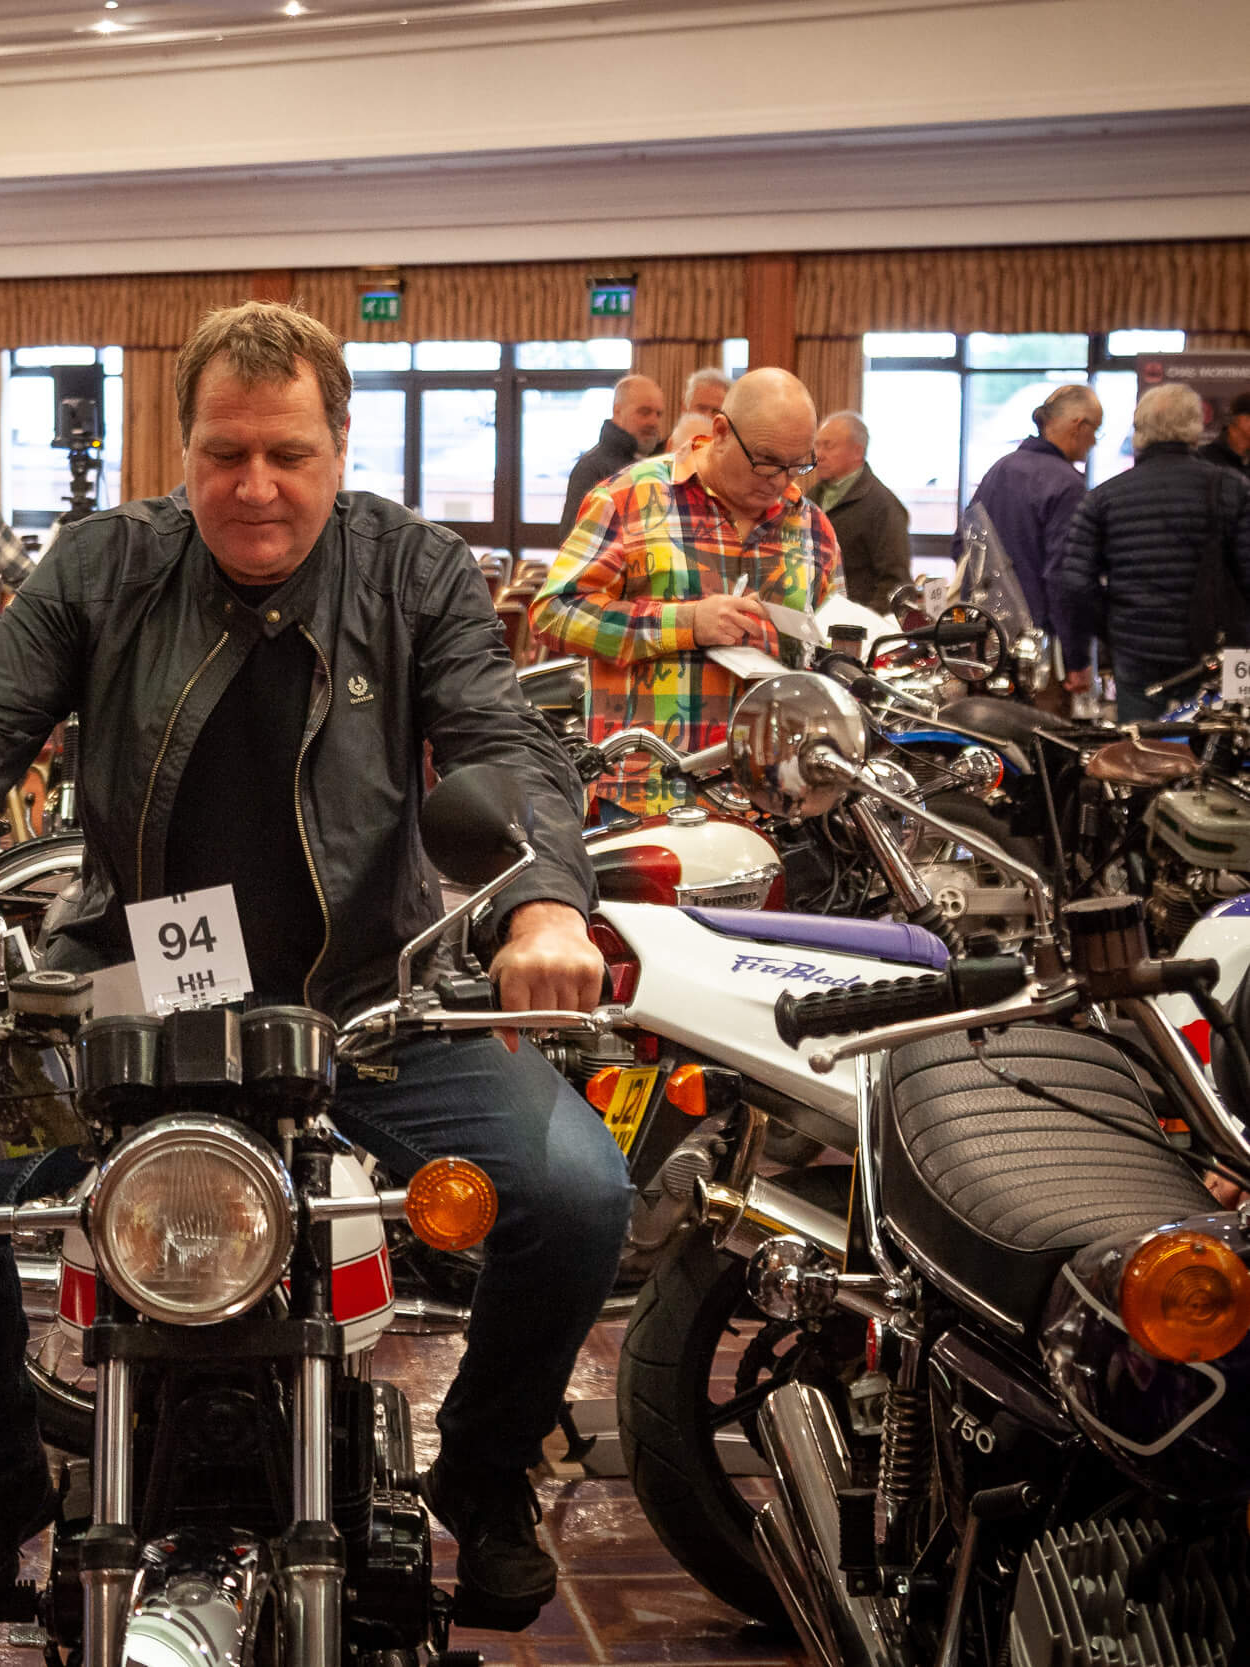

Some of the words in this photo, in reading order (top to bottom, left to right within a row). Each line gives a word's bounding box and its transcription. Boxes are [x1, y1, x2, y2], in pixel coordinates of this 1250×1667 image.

[1235, 661, 1250, 679] 6
[158, 916, 217, 961] 94
[177, 969, 215, 994] HH
[731, 954, 861, 988] FireBlad
[951, 1404, 994, 1454] 750
